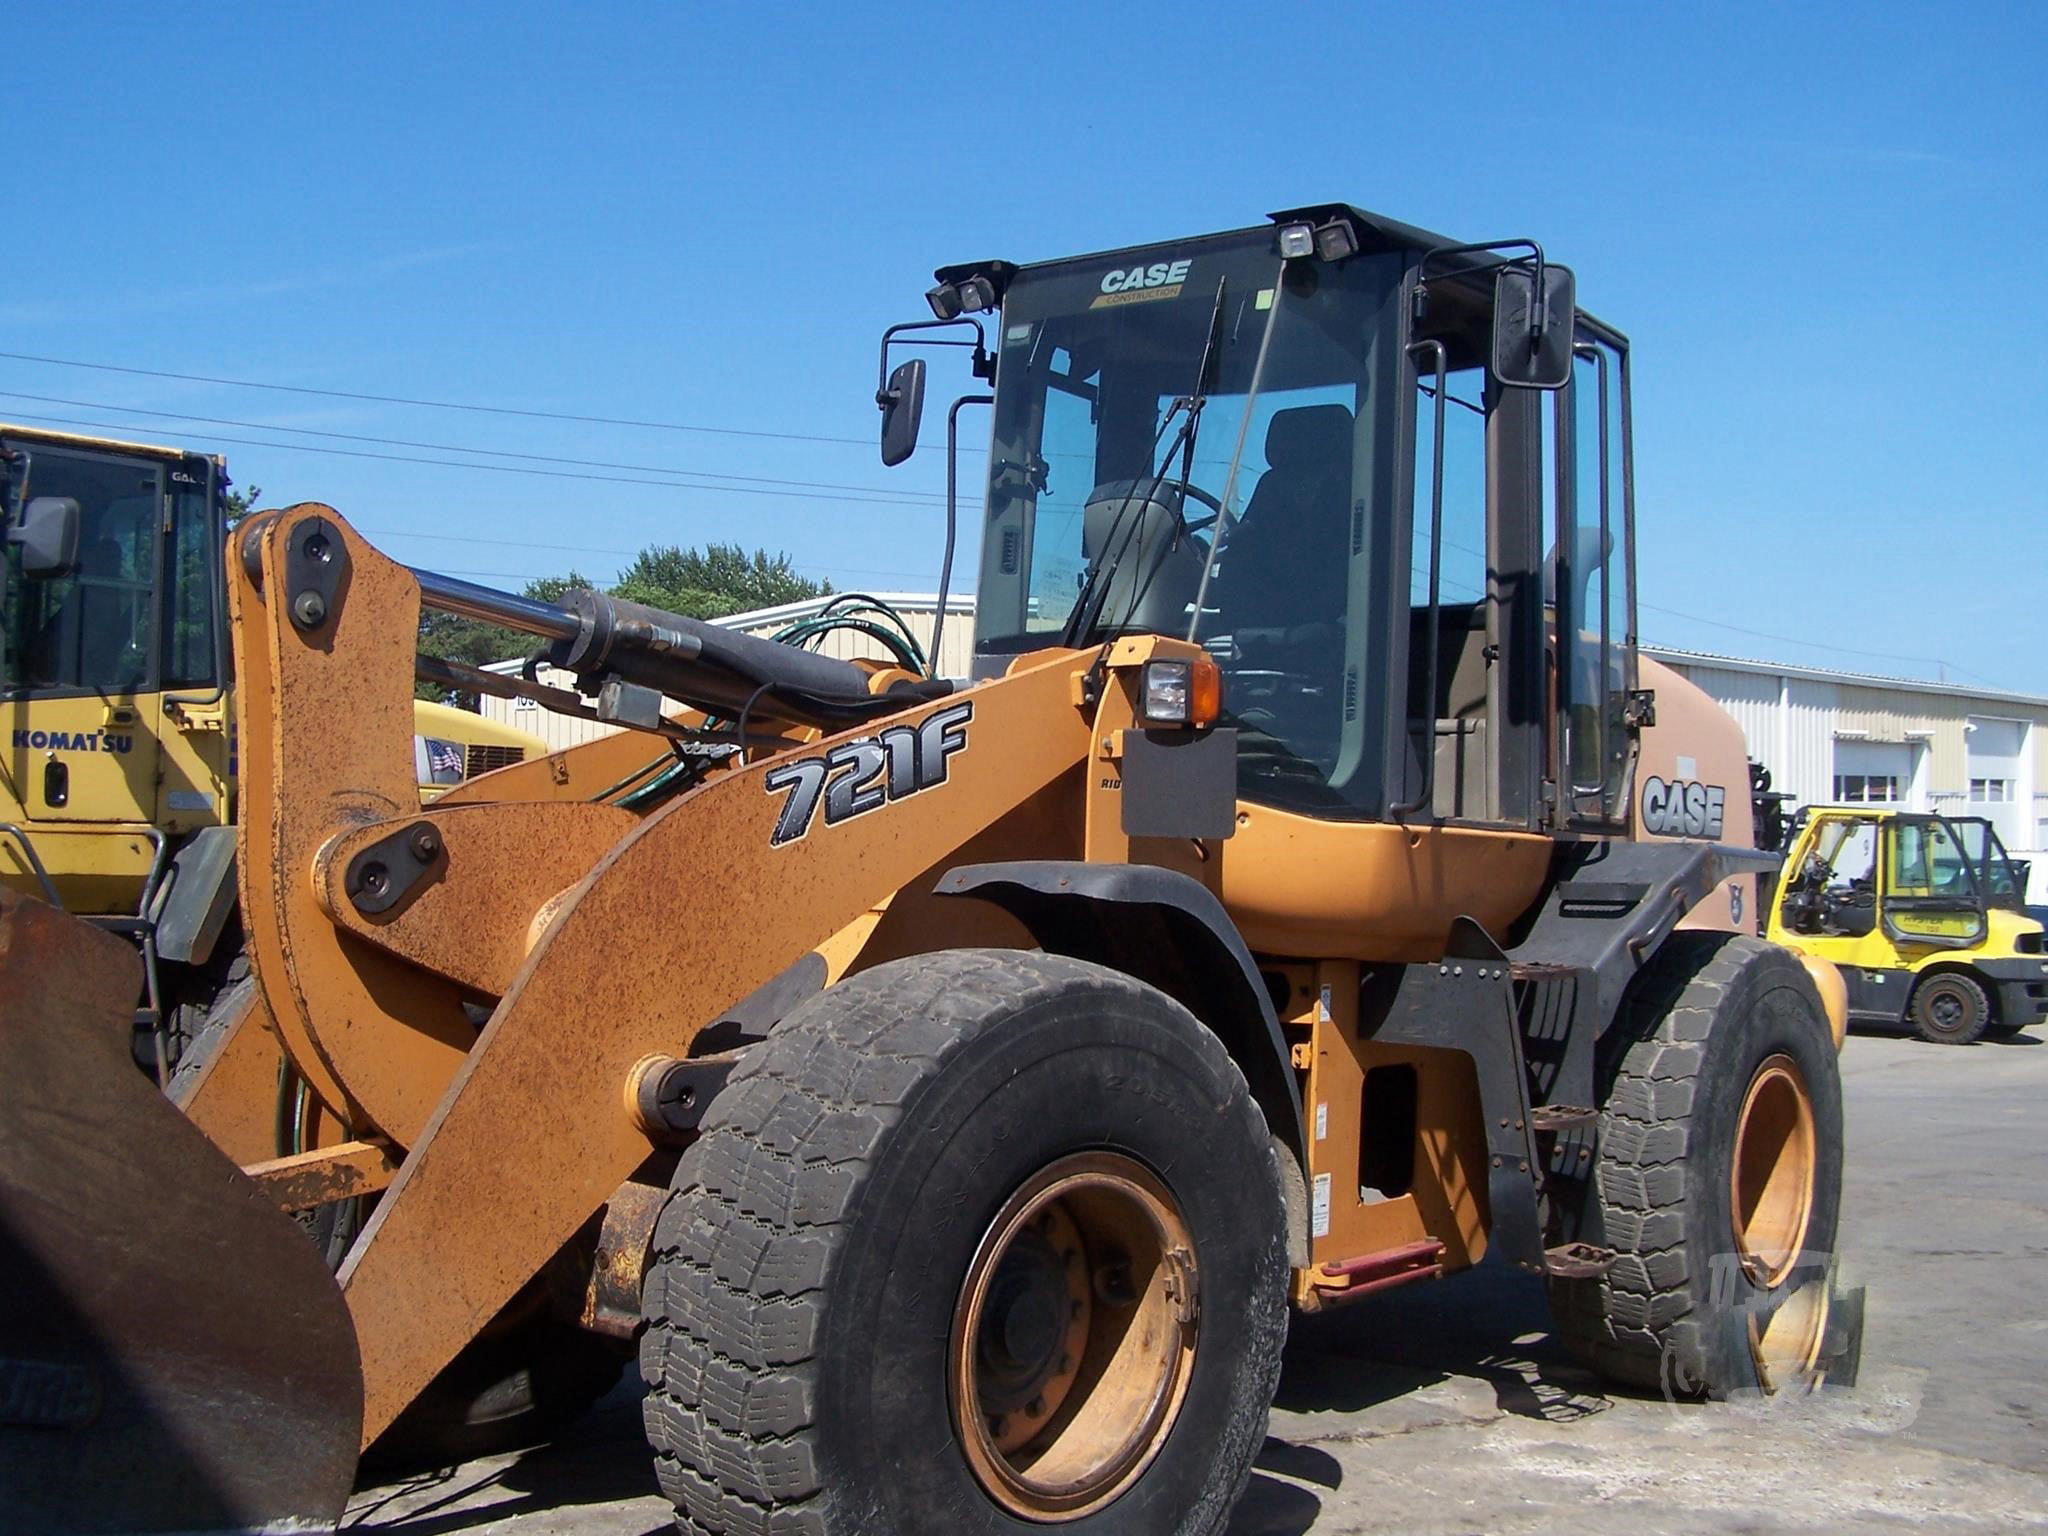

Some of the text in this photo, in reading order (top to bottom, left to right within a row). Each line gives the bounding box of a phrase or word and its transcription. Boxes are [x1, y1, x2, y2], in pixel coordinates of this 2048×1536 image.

[1101, 259, 1193, 294] CASE
[1106, 286, 1178, 305] CONSTRUCTION
[12, 729, 133, 754] KOMATSU
[765, 700, 974, 848] 721F
[1101, 778, 1121, 789] RID
[1641, 775, 1725, 841] CASE
